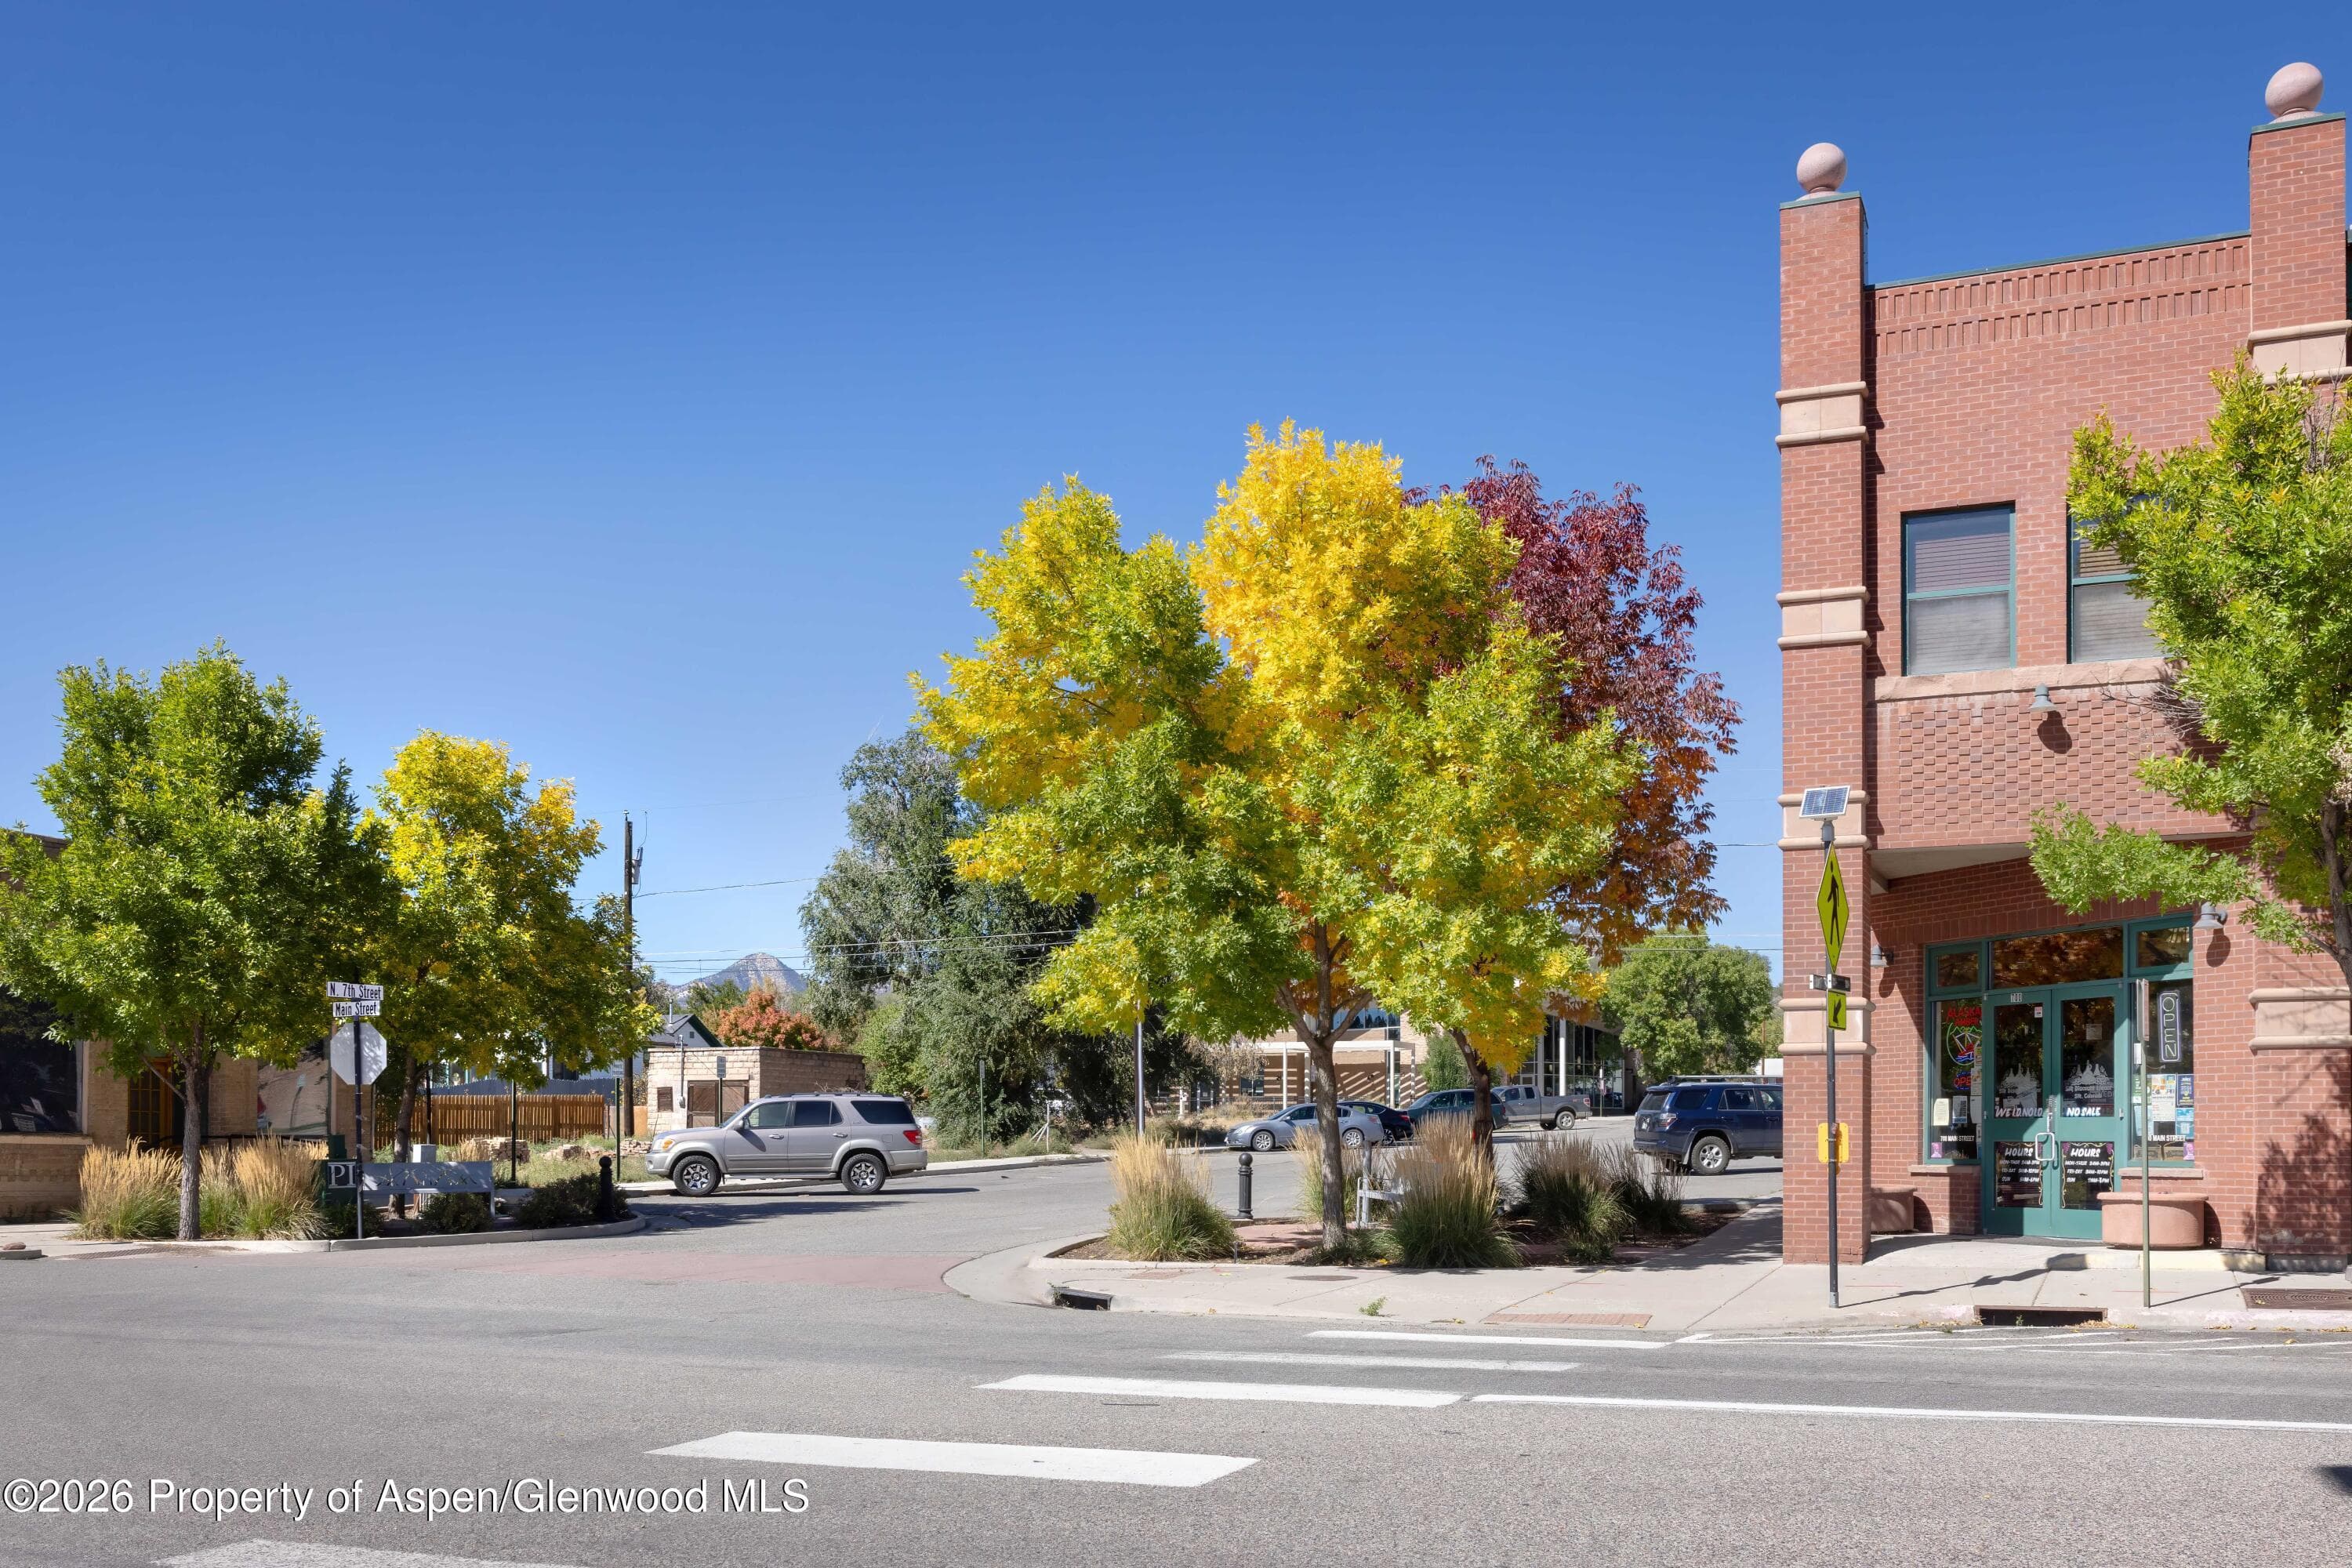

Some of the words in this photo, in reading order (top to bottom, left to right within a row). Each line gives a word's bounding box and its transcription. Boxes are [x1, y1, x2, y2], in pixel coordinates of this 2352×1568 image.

[330, 983, 339, 996] N.
[343, 984, 355, 997] 7th
[359, 985, 381, 999] Street
[336, 1003, 352, 1016] Main
[355, 1002, 376, 1015] Street
[2162, 996, 2176, 1058] OPEN
[1953, 1076, 1970, 1087] OPE
[1995, 1106, 2012, 1117] WE
[2066, 1107, 2080, 1116] NO
[2082, 1107, 2101, 1116] SALE
[2005, 1148, 2034, 1156] HOURS
[2071, 1149, 2101, 1157] HOURS
